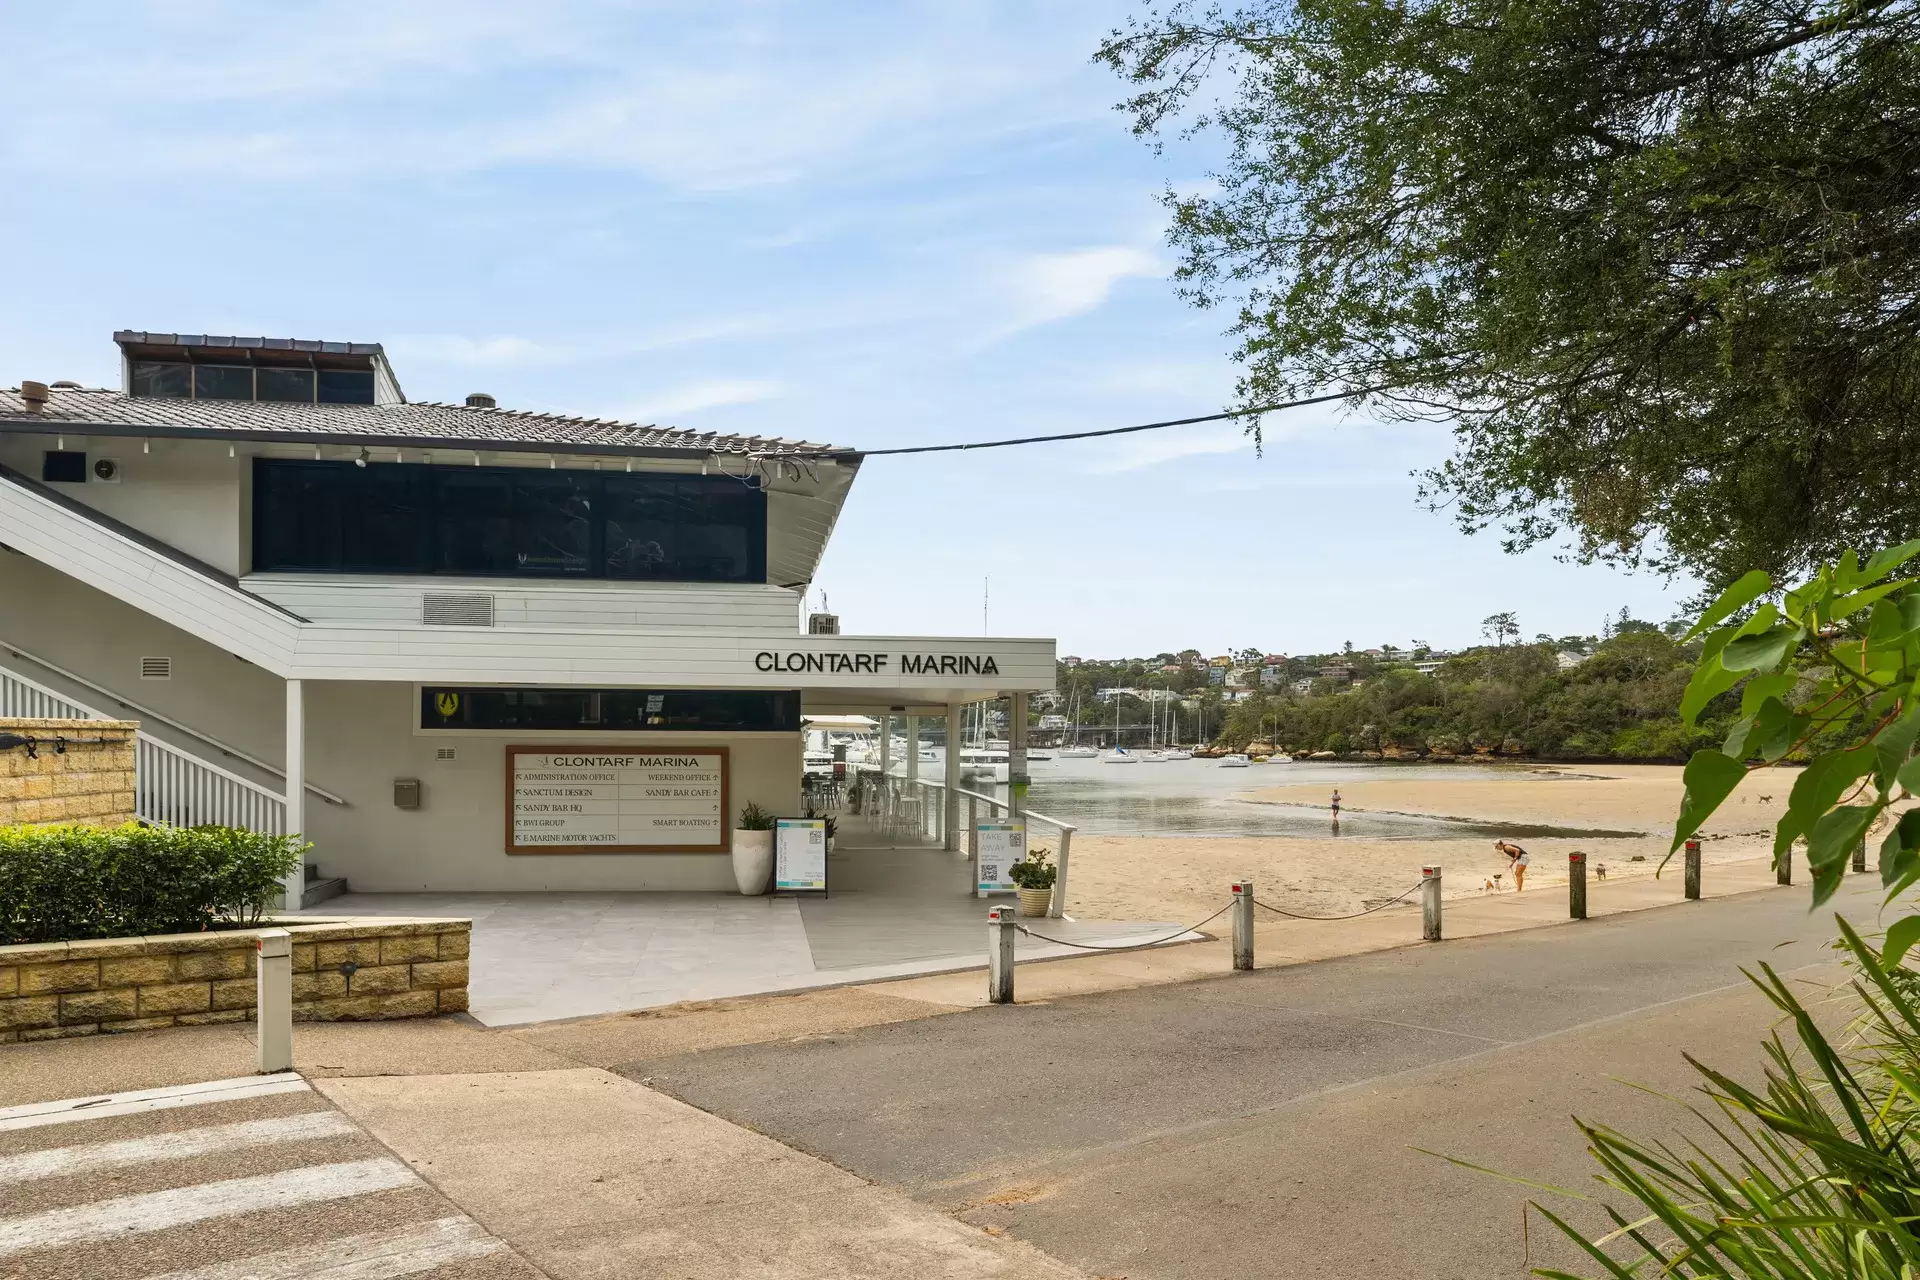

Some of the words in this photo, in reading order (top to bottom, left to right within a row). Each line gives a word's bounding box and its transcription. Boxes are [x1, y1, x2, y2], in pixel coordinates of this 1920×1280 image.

[755, 652, 888, 673] CLONTARF
[901, 654, 999, 675] MARINA
[553, 757, 635, 767] CLONTARF
[639, 757, 699, 767] MARINA
[523, 804, 550, 812] SANDY
[552, 804, 569, 812] BAR
[570, 804, 583, 813] HQ
[588, 834, 616, 842] YACHTS
[980, 833, 1002, 841] TAKE
[980, 844, 1005, 852] AWAY
